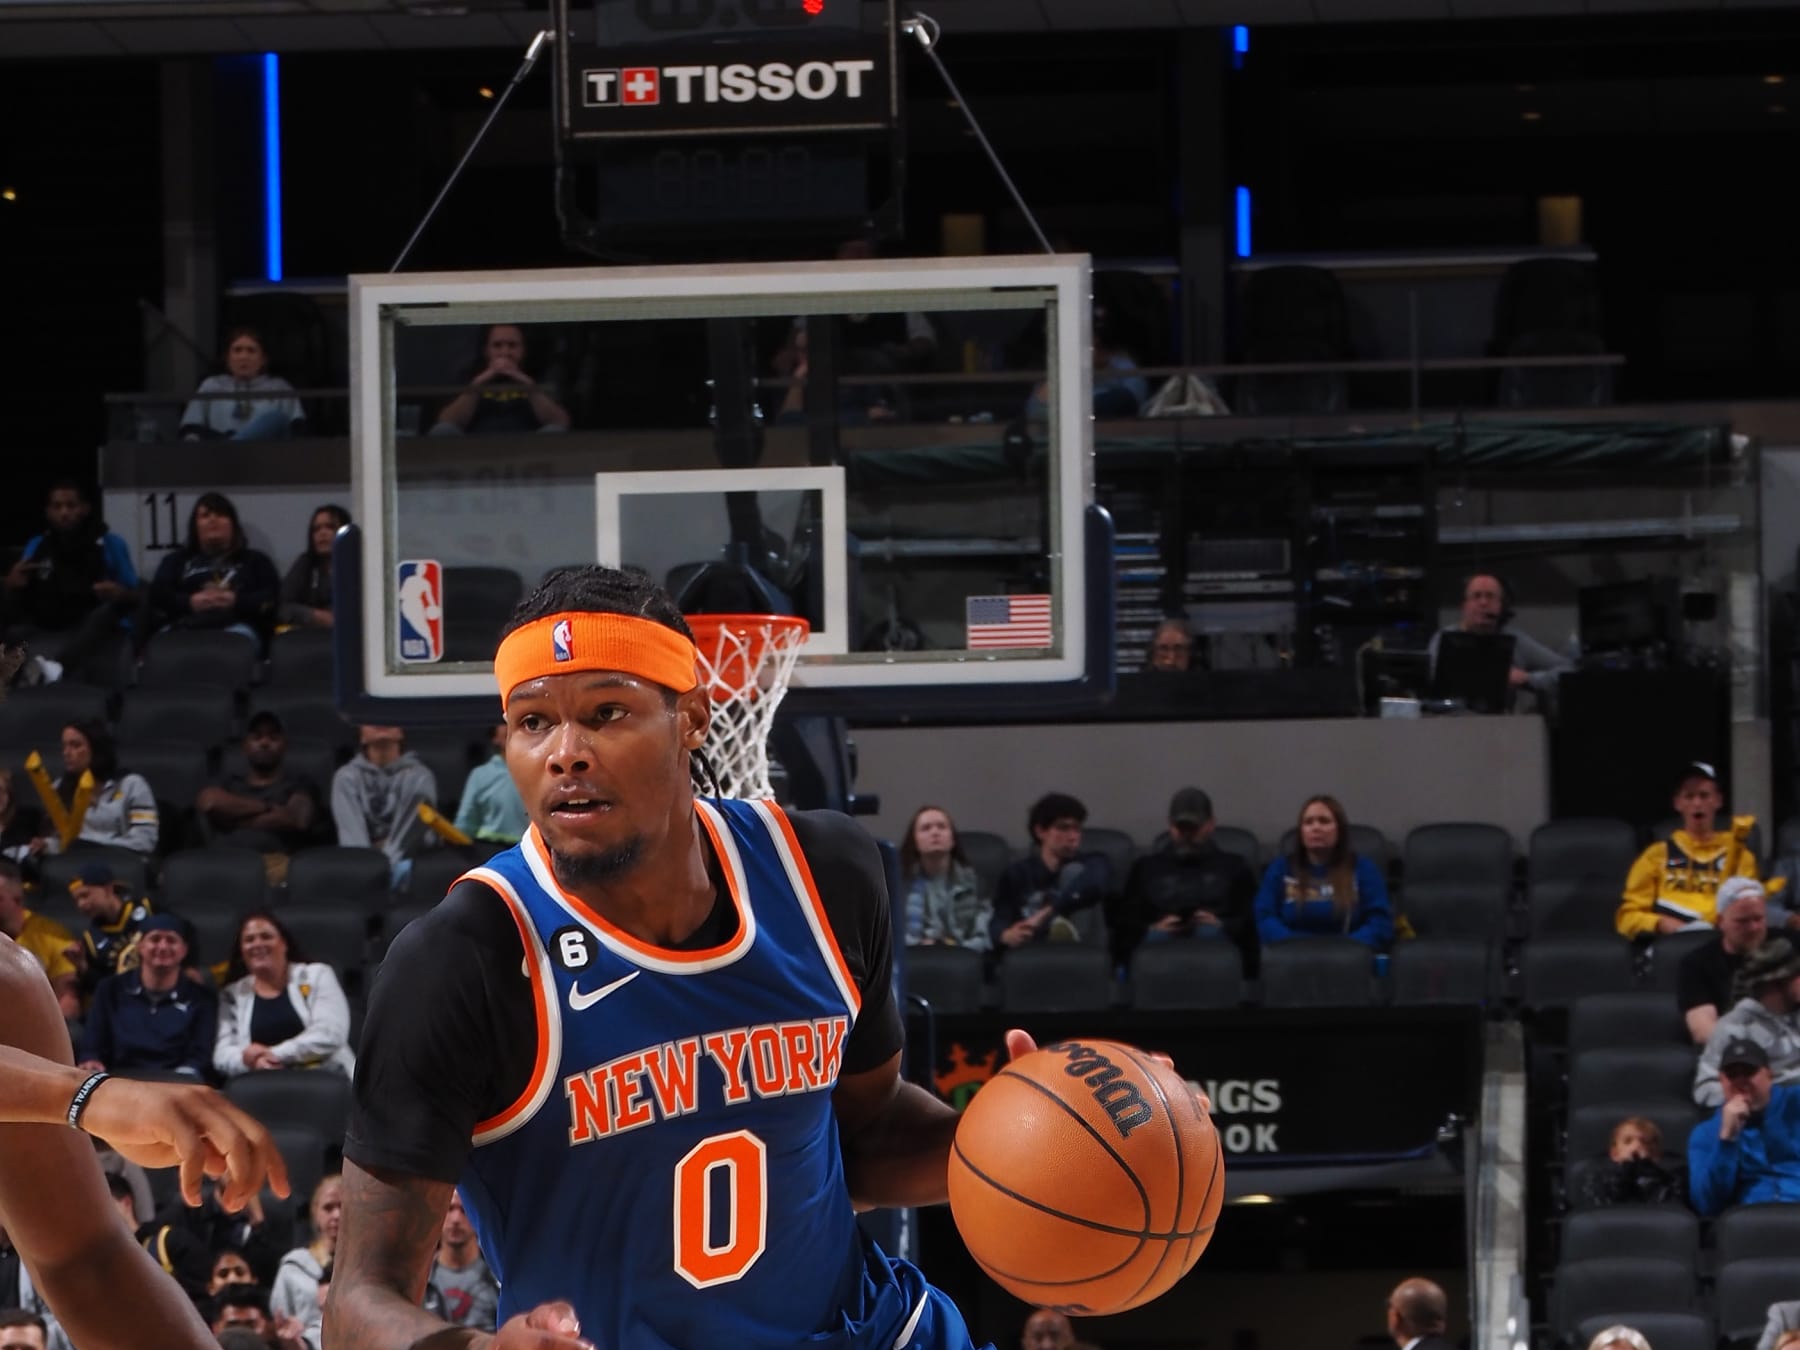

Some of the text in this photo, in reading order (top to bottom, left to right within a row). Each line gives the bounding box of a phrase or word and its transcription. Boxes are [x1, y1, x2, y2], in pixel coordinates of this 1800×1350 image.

[662, 60, 874, 103] TISSOT
[144, 492, 184, 551] 11
[558, 930, 590, 968] 6
[564, 1015, 849, 1147] NEW YORK
[1218, 1123, 1279, 1153] OK
[673, 1129, 767, 1290] 0
